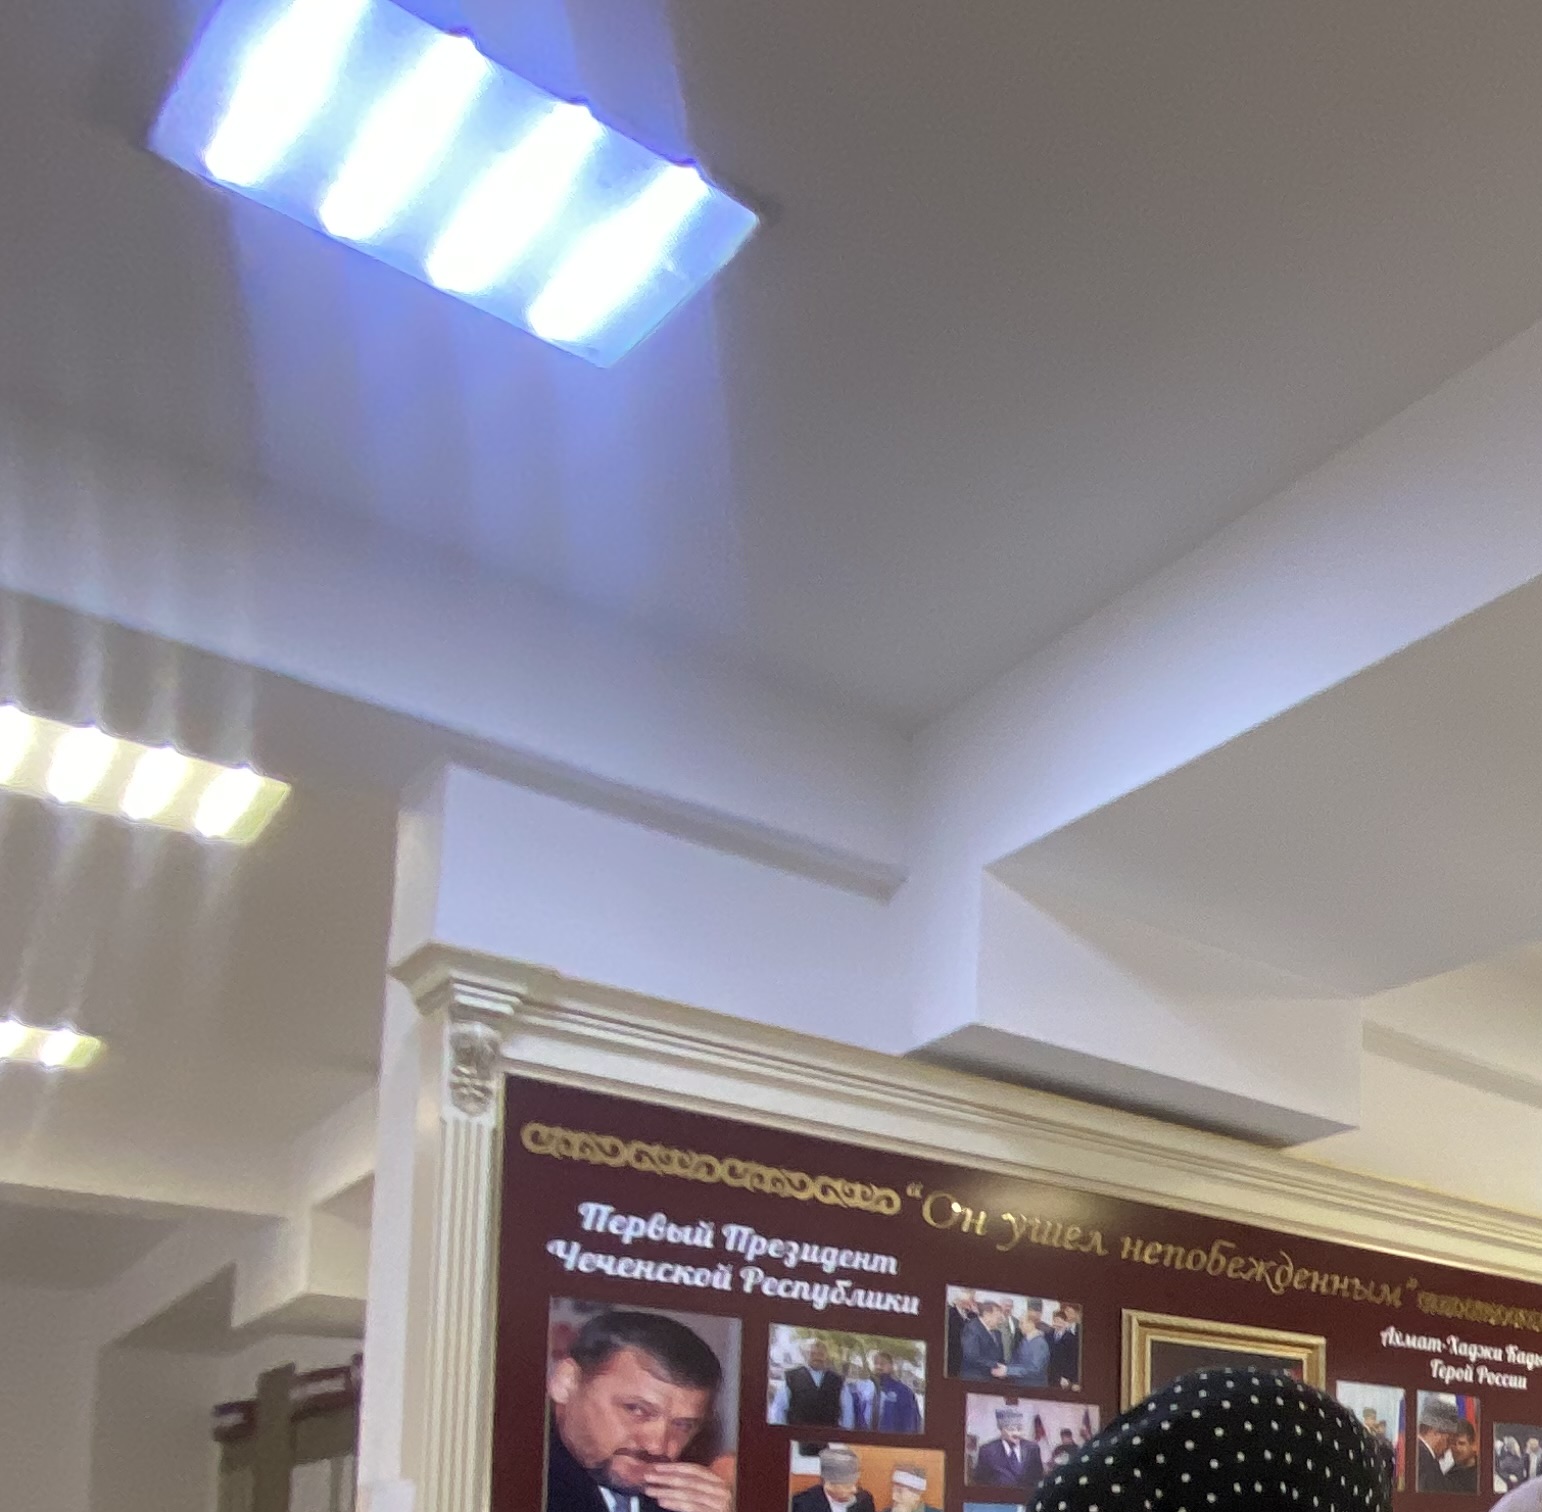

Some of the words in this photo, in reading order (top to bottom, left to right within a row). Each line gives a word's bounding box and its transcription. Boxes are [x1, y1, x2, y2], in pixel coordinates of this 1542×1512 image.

[578, 1201, 715, 1249] Первый
[721, 1223, 899, 1276] Президент
[995, 1212, 1109, 1257] ушел
[546, 1239, 733, 1292] Чеченской
[739, 1265, 921, 1317] Республики
[1379, 1325, 1504, 1363] Ахмат-Хаджи
[1429, 1358, 1475, 1385] Герой
[1475, 1364, 1529, 1391] России
